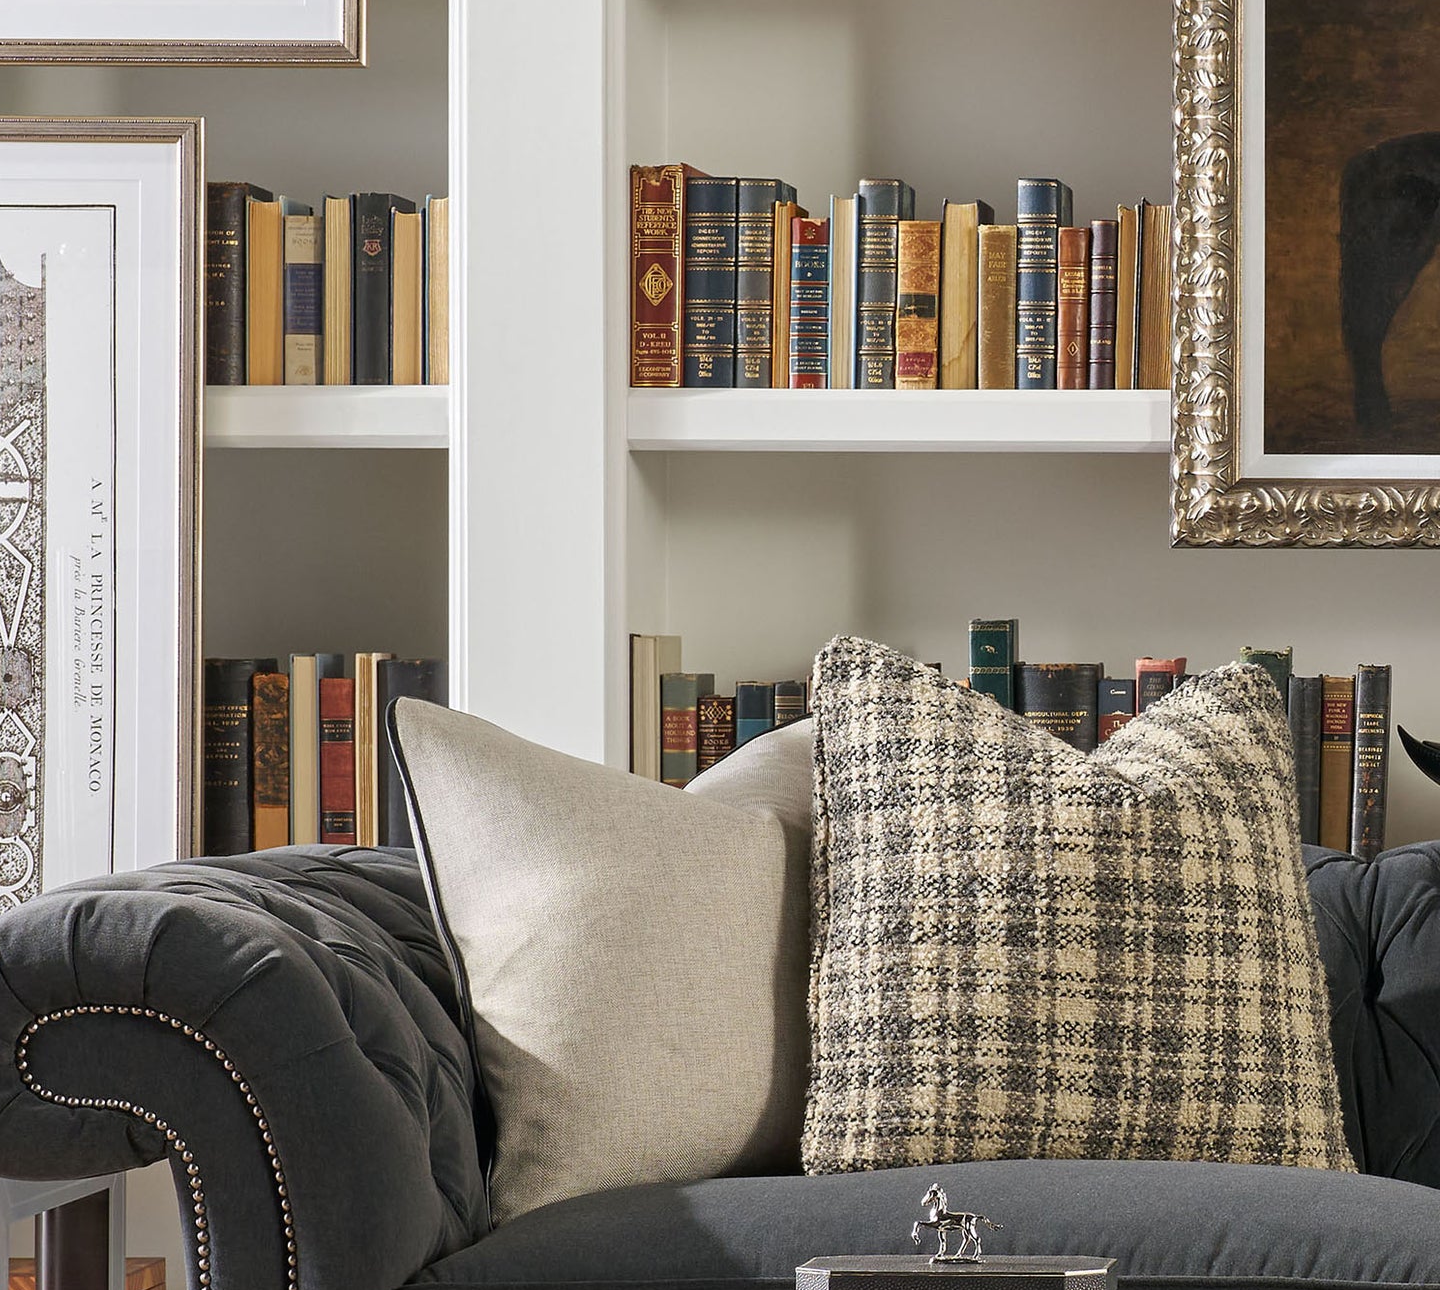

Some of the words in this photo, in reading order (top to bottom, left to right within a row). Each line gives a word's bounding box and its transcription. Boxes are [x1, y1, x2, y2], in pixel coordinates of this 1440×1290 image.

[987, 251, 1006, 260] MAY
[794, 259, 825, 269] BOOKS
[988, 261, 1006, 269] FAIR
[90, 477, 103, 491] A
[90, 533, 103, 561] LA
[89, 573, 104, 674] PRINCESSE
[90, 683, 103, 709] DE
